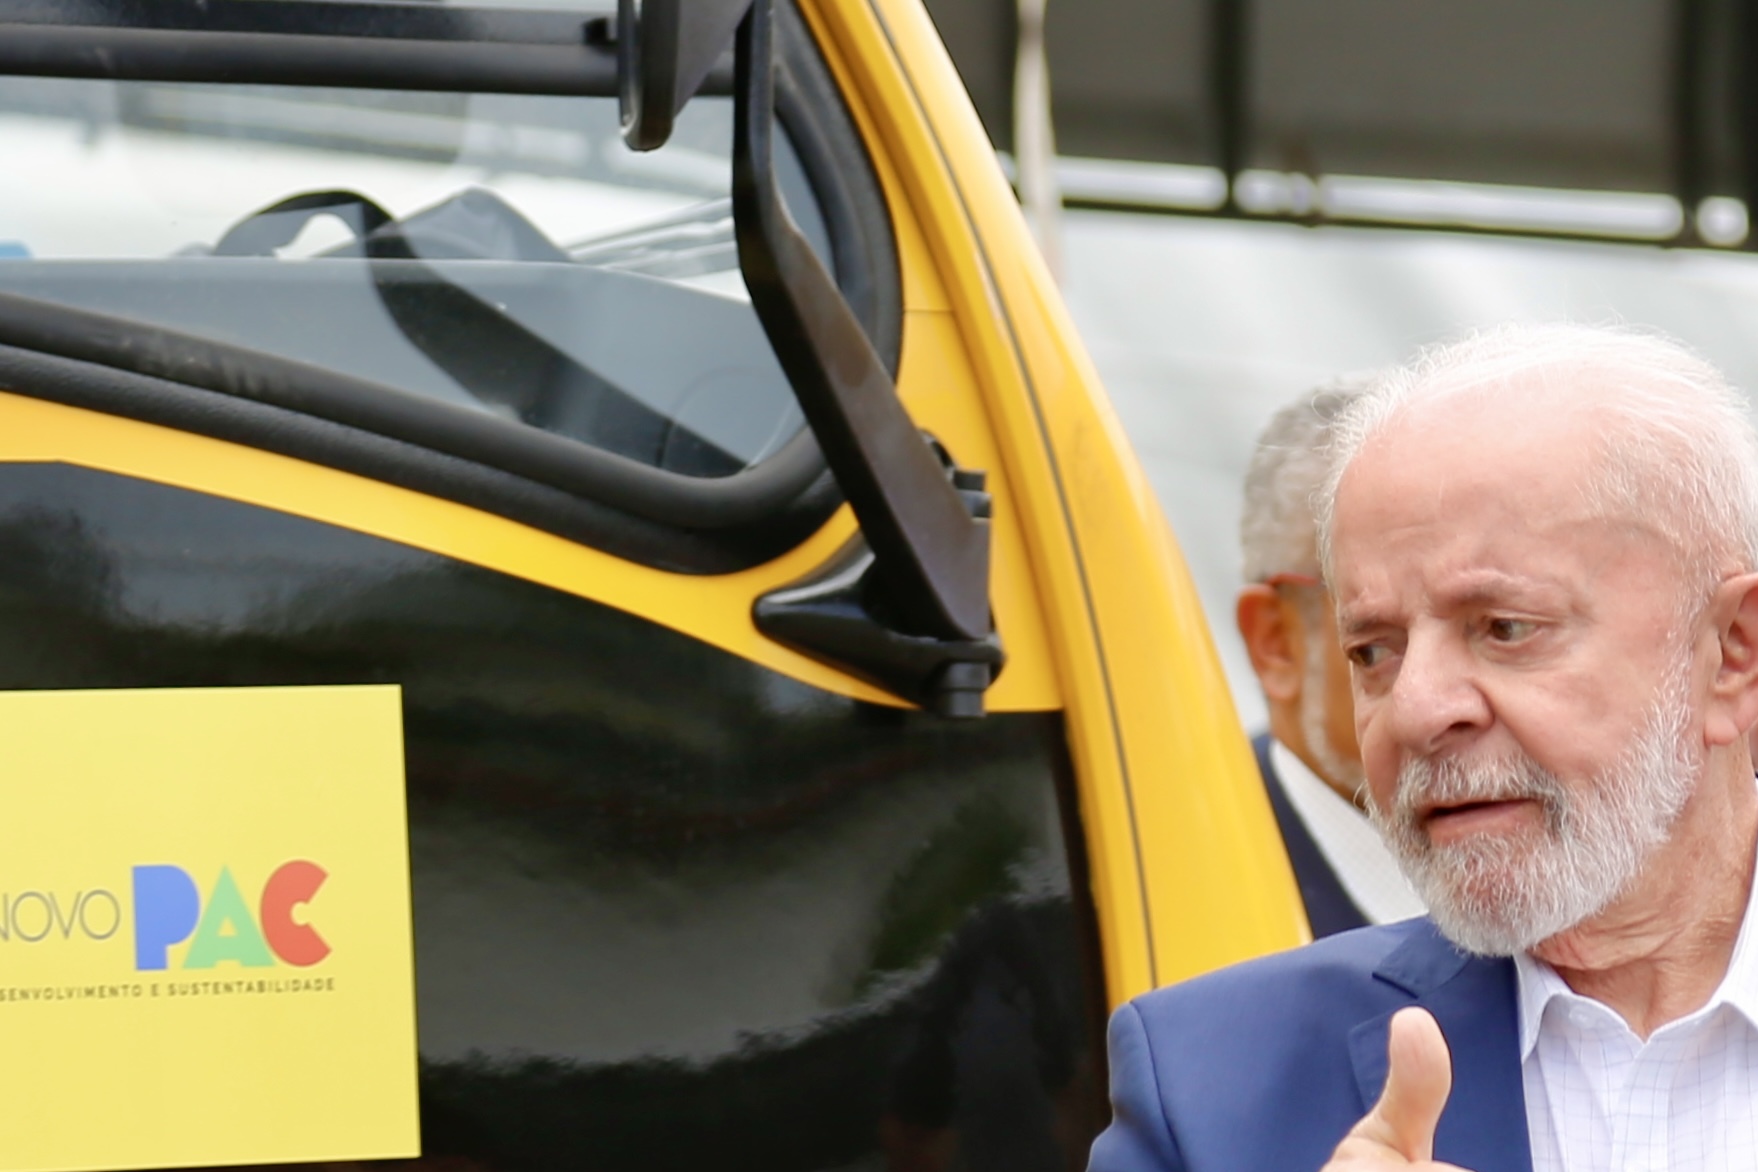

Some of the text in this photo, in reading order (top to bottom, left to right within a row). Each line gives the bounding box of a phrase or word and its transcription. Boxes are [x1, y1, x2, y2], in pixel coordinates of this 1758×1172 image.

[132, 859, 332, 971] PAC
[151, 983, 160, 997] E
[168, 977, 335, 997] SUSTENTABILIDADE
